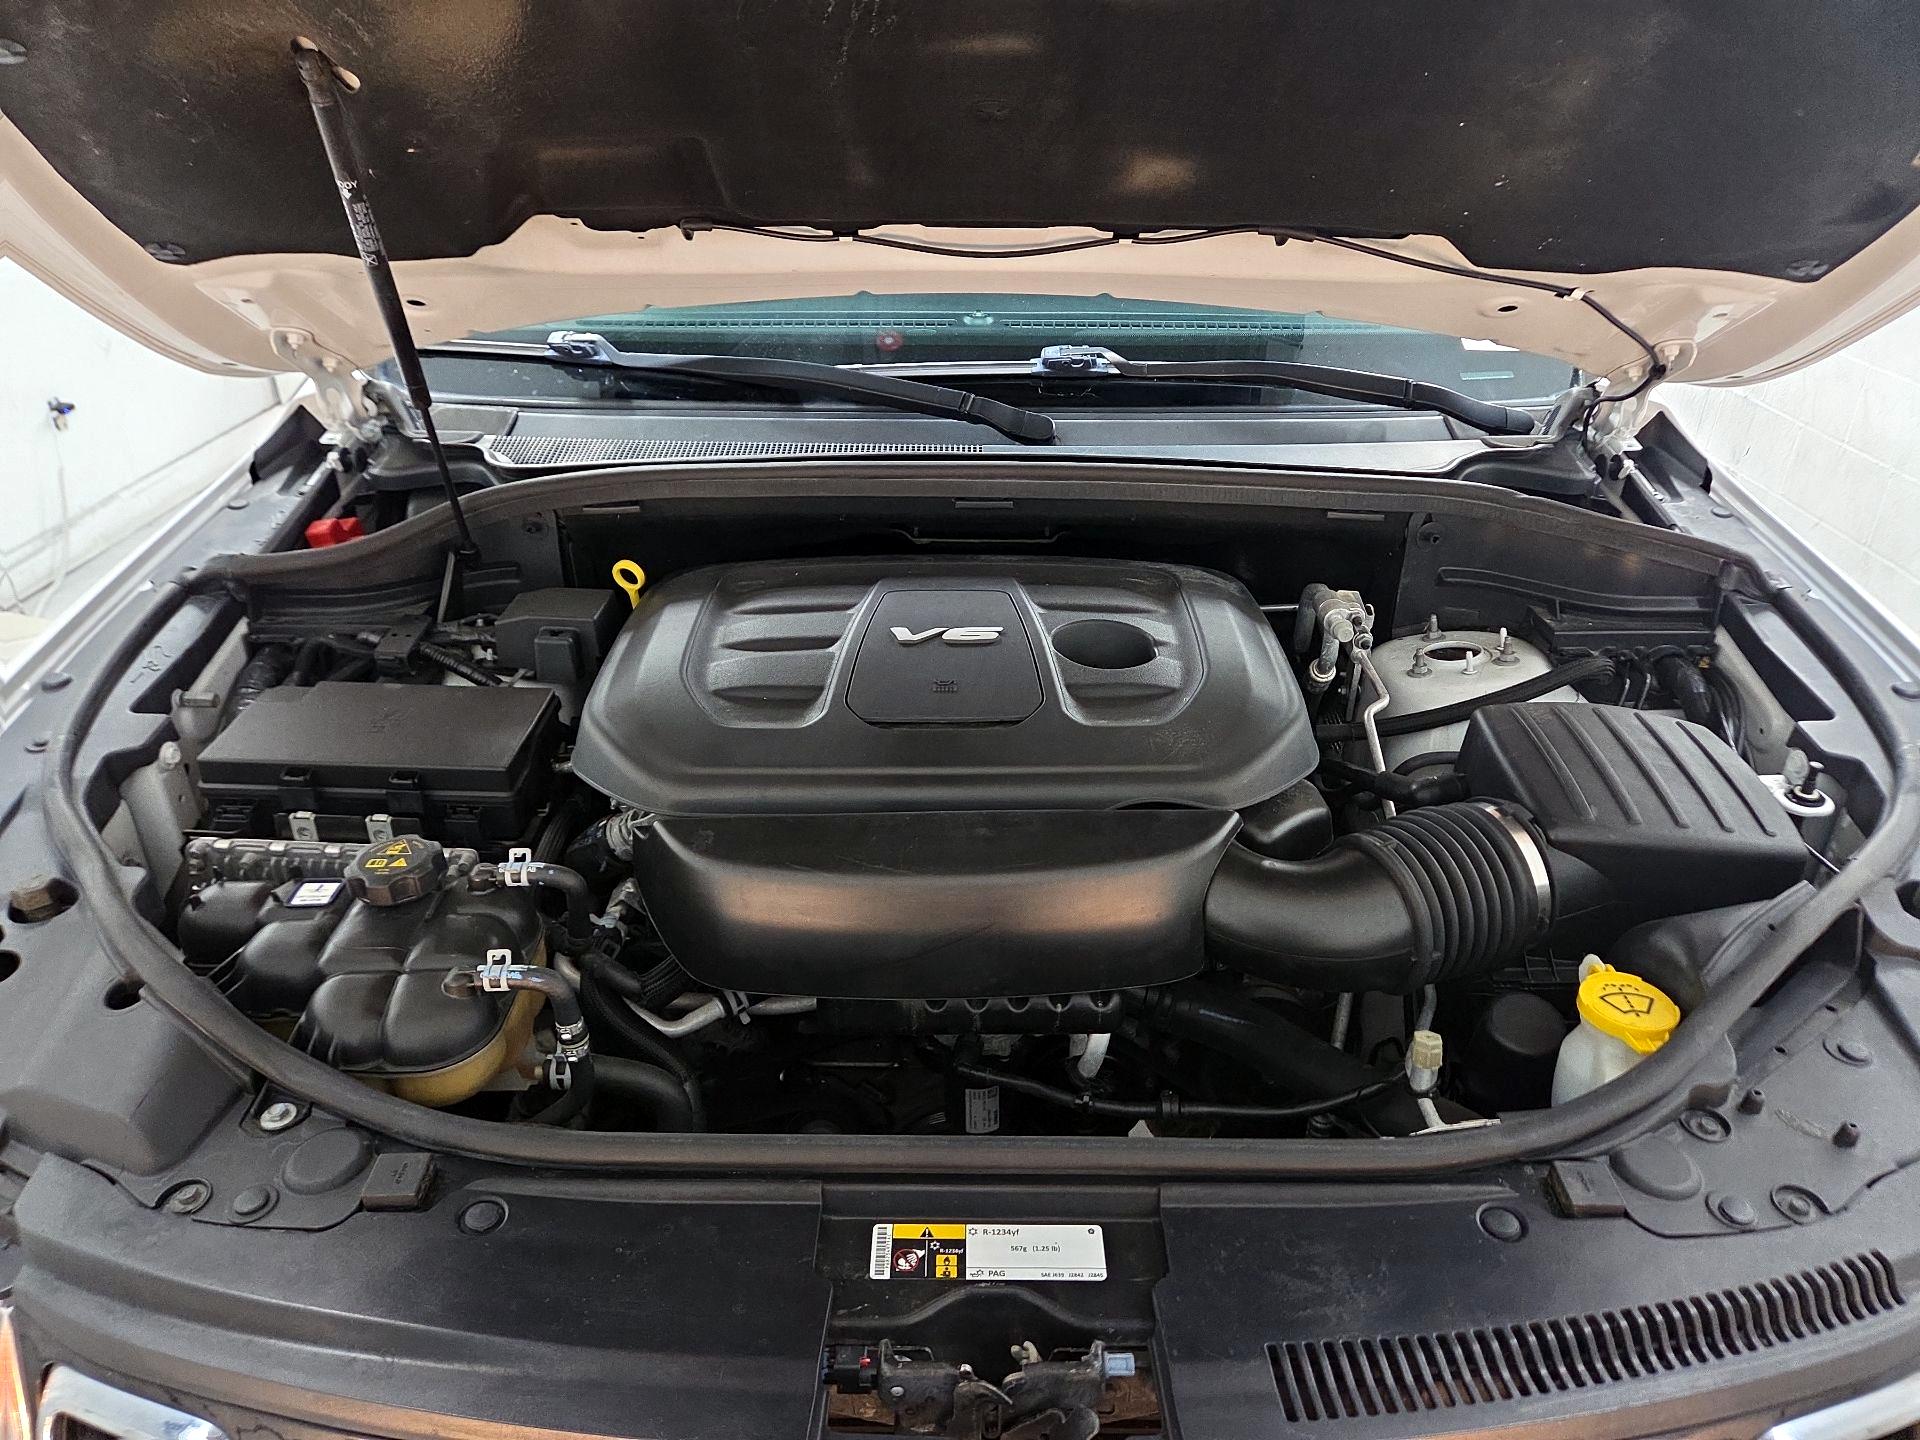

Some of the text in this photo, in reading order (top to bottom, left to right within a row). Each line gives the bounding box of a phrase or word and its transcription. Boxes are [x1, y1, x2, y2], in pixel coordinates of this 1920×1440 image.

[336, 179, 358, 190] ODY
[889, 626, 1004, 644] V6
[982, 1228, 1020, 1237] R-1234yf
[1010, 1245, 1061, 1253] 567g (1.25 lb)
